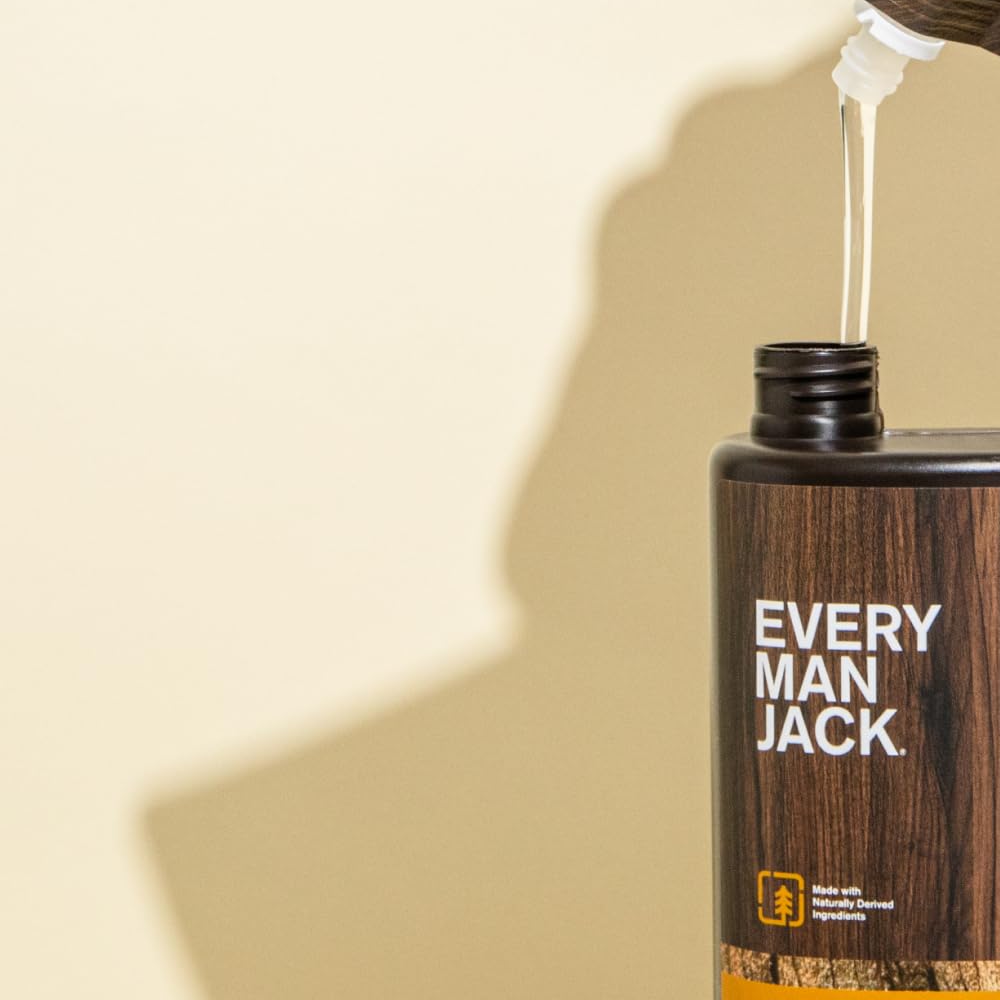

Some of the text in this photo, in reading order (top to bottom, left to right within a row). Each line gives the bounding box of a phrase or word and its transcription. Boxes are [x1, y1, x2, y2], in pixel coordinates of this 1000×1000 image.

[755, 599, 942, 652] EVERY
[755, 651, 878, 704] MAN
[812, 885, 862, 896] Made with
[812, 897, 895, 910] Naturally Derived
[812, 909, 867, 922] Ingredients
